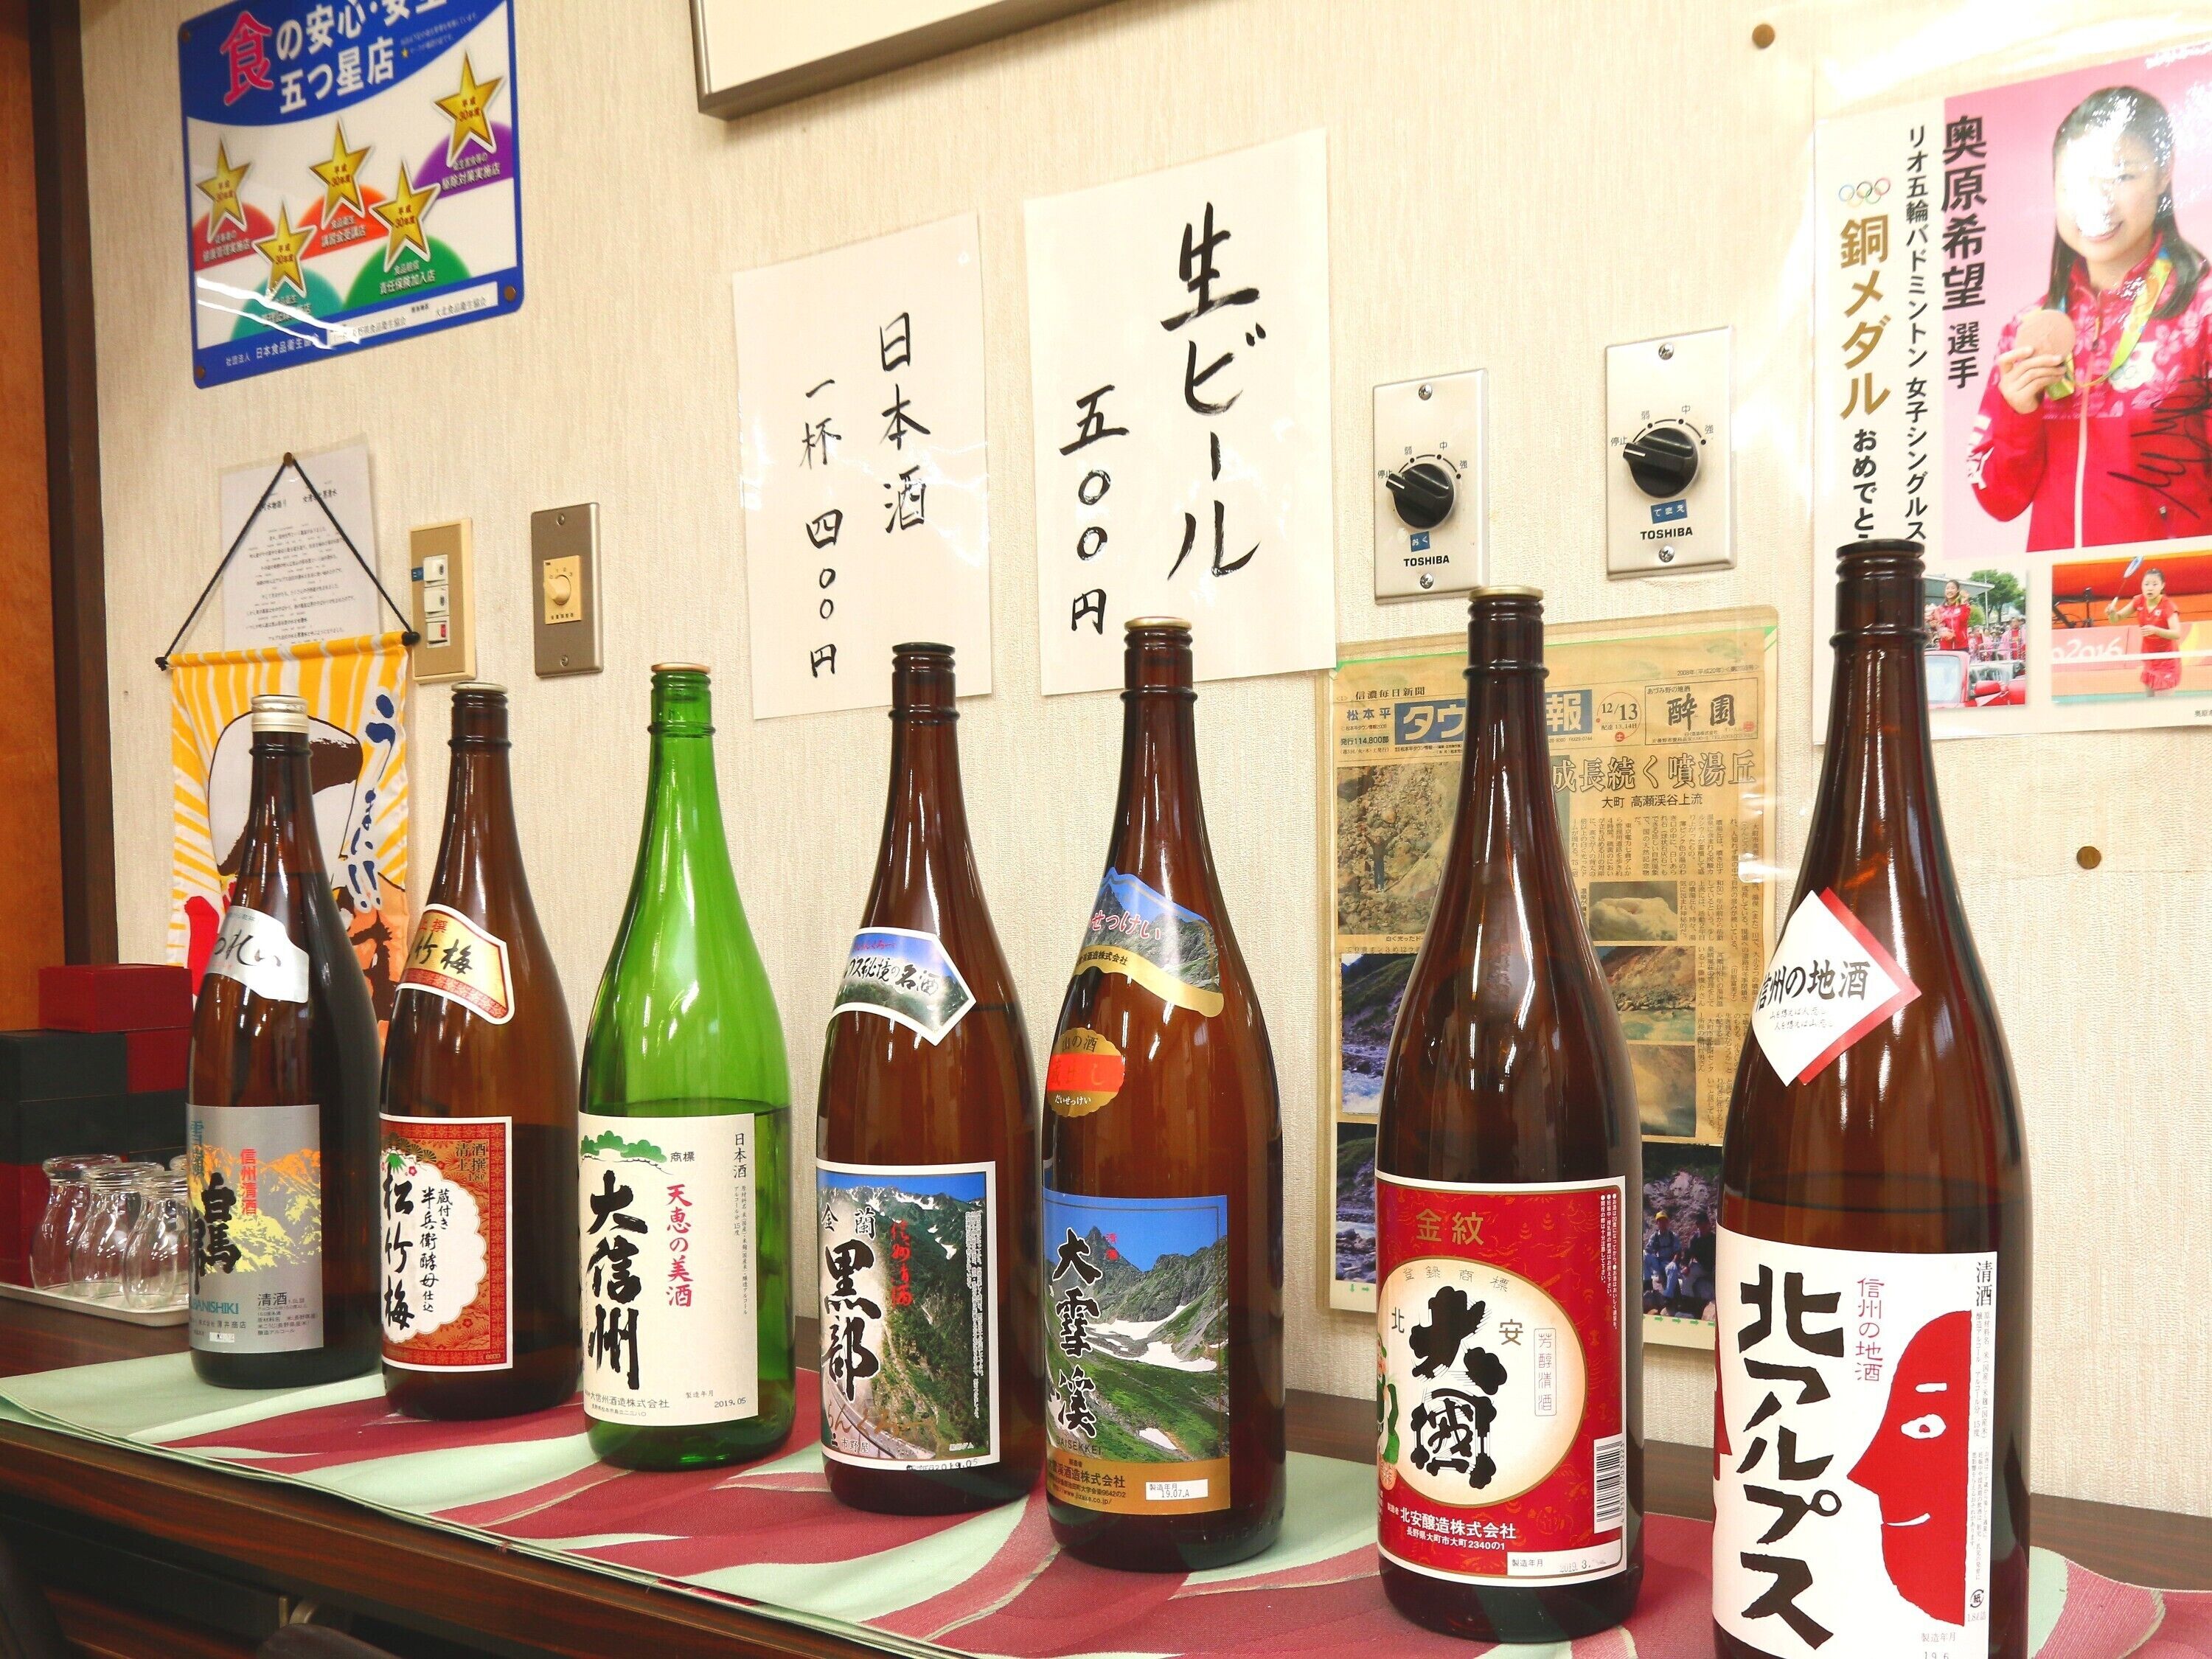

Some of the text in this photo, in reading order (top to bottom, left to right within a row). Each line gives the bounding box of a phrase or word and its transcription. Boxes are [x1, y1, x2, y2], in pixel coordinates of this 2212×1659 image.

[279, 36, 395, 114] 五つ星店
[1941, 114, 1986, 389] 奥原希望 選手
[1840, 214, 1891, 422] 銅メダル
[1905, 125, 1929, 540] リオ五輪バドミントン 女子シングルス
[1160, 201, 1266, 580] 生ビール
[879, 312, 931, 533] 日本酒
[1682, 405, 1691, 415] 中
[1439, 441, 1447, 451] 中
[1610, 436, 1628, 446] 停止
[1851, 428, 1877, 540] おめでと
[1640, 526, 1694, 540] TOSHIBA
[1404, 554, 1450, 568] TOSHIBA
[1355, 686, 1425, 700] 信濃毎日新聞
[1545, 692, 1582, 732] 報
[1601, 702, 1638, 721] 12/13
[1346, 707, 1391, 721] 松本平
[1340, 735, 1389, 746] 発行114,800部
[1601, 793, 1703, 809] 大町 高瀬渓谷上流
[415, 931, 473, 975] 竹梅
[1756, 959, 1871, 1013] 信州の地酒
[1054, 1093, 1092, 1106] だいせっけい
[670, 1151, 695, 1163] 商標
[733, 1133, 747, 1179] 日本酒
[240, 1148, 257, 1216] 信州清酒
[437, 1189, 453, 1230] 蔵付き
[1415, 1208, 1484, 1246] 金紋
[383, 1163, 415, 1330] 松竹梅
[666, 1183, 694, 1308] 天恵の美酒
[586, 1169, 648, 1391] 大信州
[1402, 1265, 1509, 1293] 登録商標
[1975, 1260, 1993, 1307] 清酒
[257, 1291, 288, 1307] 清酒
[824, 1239, 883, 1402] 黒部
[1391, 1307, 1523, 1346] 北 安
[1854, 1276, 1885, 1382] 信州の地酒
[590, 1393, 670, 1409] 大信州酒造株式会社
[686, 1390, 714, 1399] 製造年月
[714, 1397, 747, 1409] 2019.05
[1736, 1263, 1844, 1651] 北アルプス
[1400, 1506, 1517, 1540] 北安醸造株式会社
[1406, 1526, 1506, 1551] 長野県大町市大町2340の1
[1512, 1559, 1544, 1568] 製造年月
[1921, 1631, 1956, 1643] 製造年月
